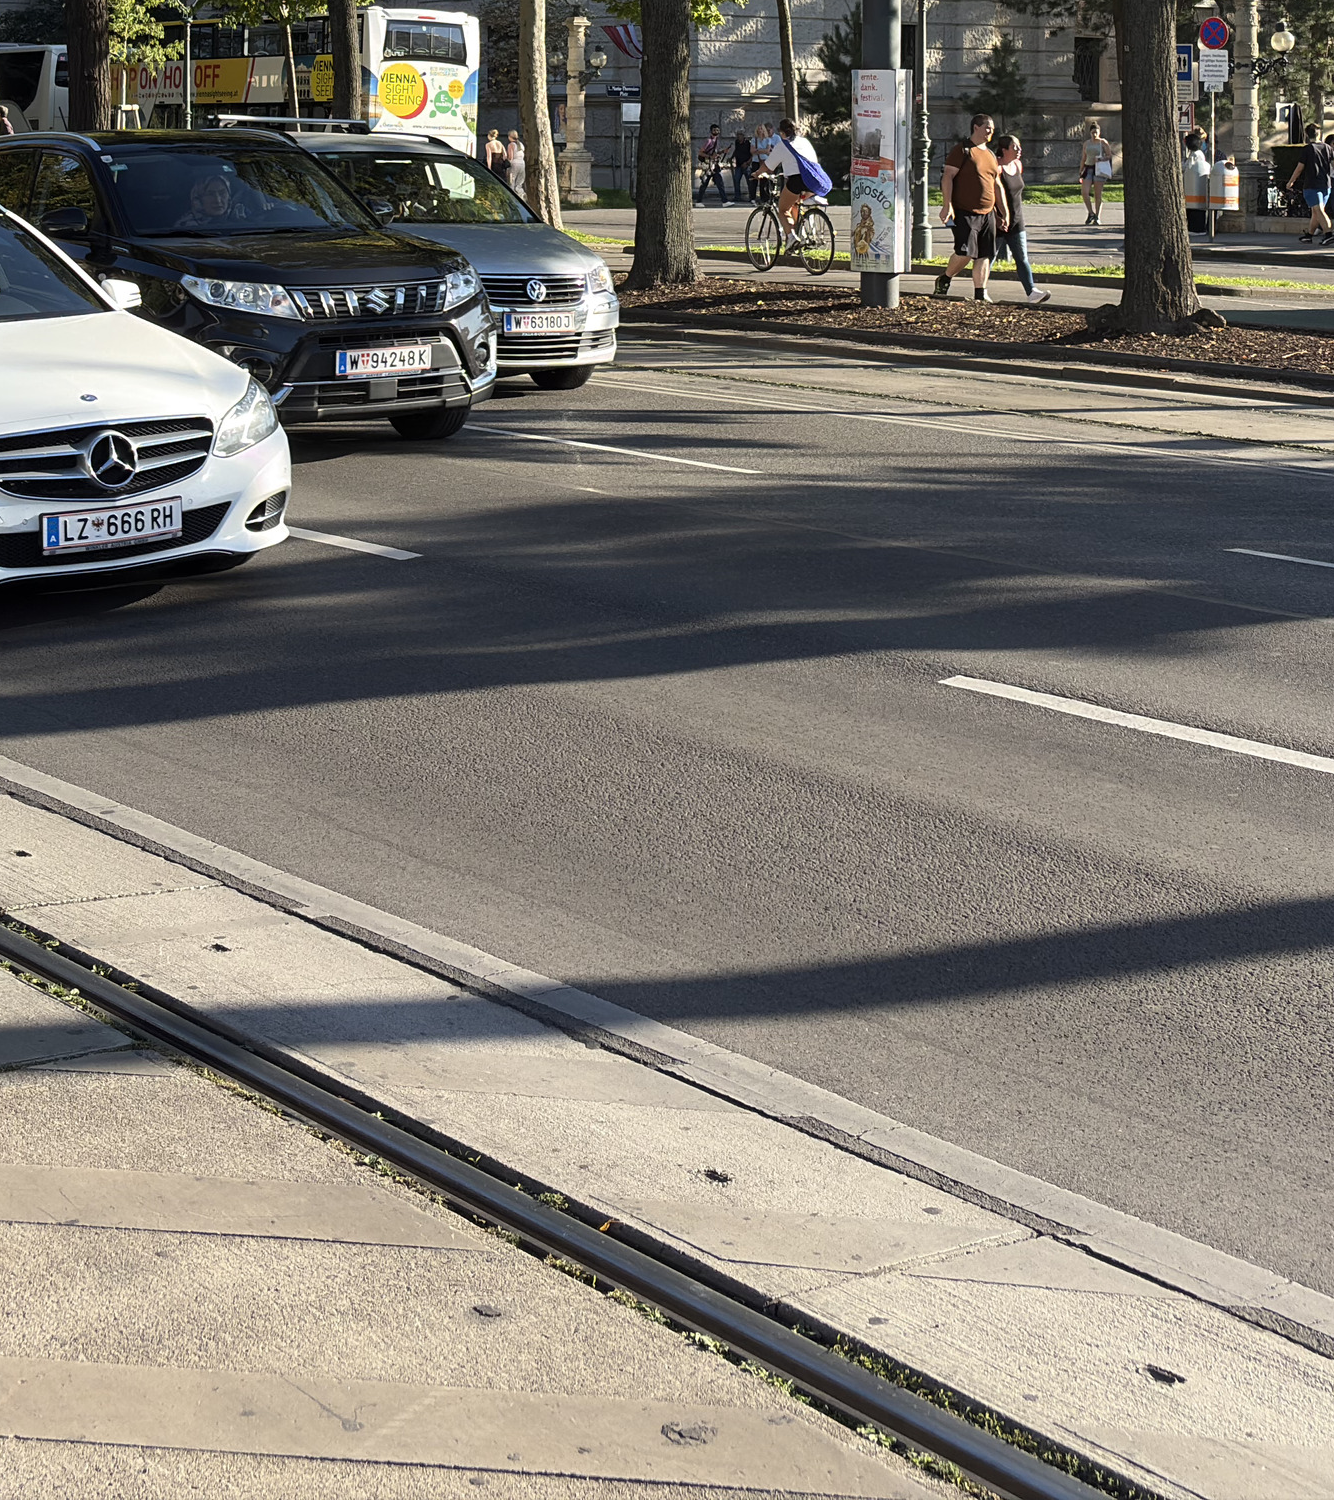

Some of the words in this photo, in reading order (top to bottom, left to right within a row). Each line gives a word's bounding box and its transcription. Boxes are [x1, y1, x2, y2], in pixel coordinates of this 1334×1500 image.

[313, 60, 334, 72] VIENN
[140, 66, 157, 89] ON
[163, 66, 182, 89] HO
[194, 64, 221, 88] OFF
[316, 73, 334, 83] SIGH
[381, 73, 417, 84] VIENNA
[315, 85, 333, 97] SEEI
[385, 84, 415, 95] SIGHT
[860, 83, 878, 91] dank.
[385, 95, 422, 106] SEEING
[860, 93, 885, 102] festival.
[514, 316, 522, 329] W
[530, 316, 562, 329] 63180
[349, 354, 361, 370] W
[371, 350, 415, 369] 94248
[418, 349, 427, 365] K
[50, 535, 57, 543] A
[64, 518, 89, 542] LZ
[107, 510, 145, 536] 666
[151, 504, 173, 530] RH
